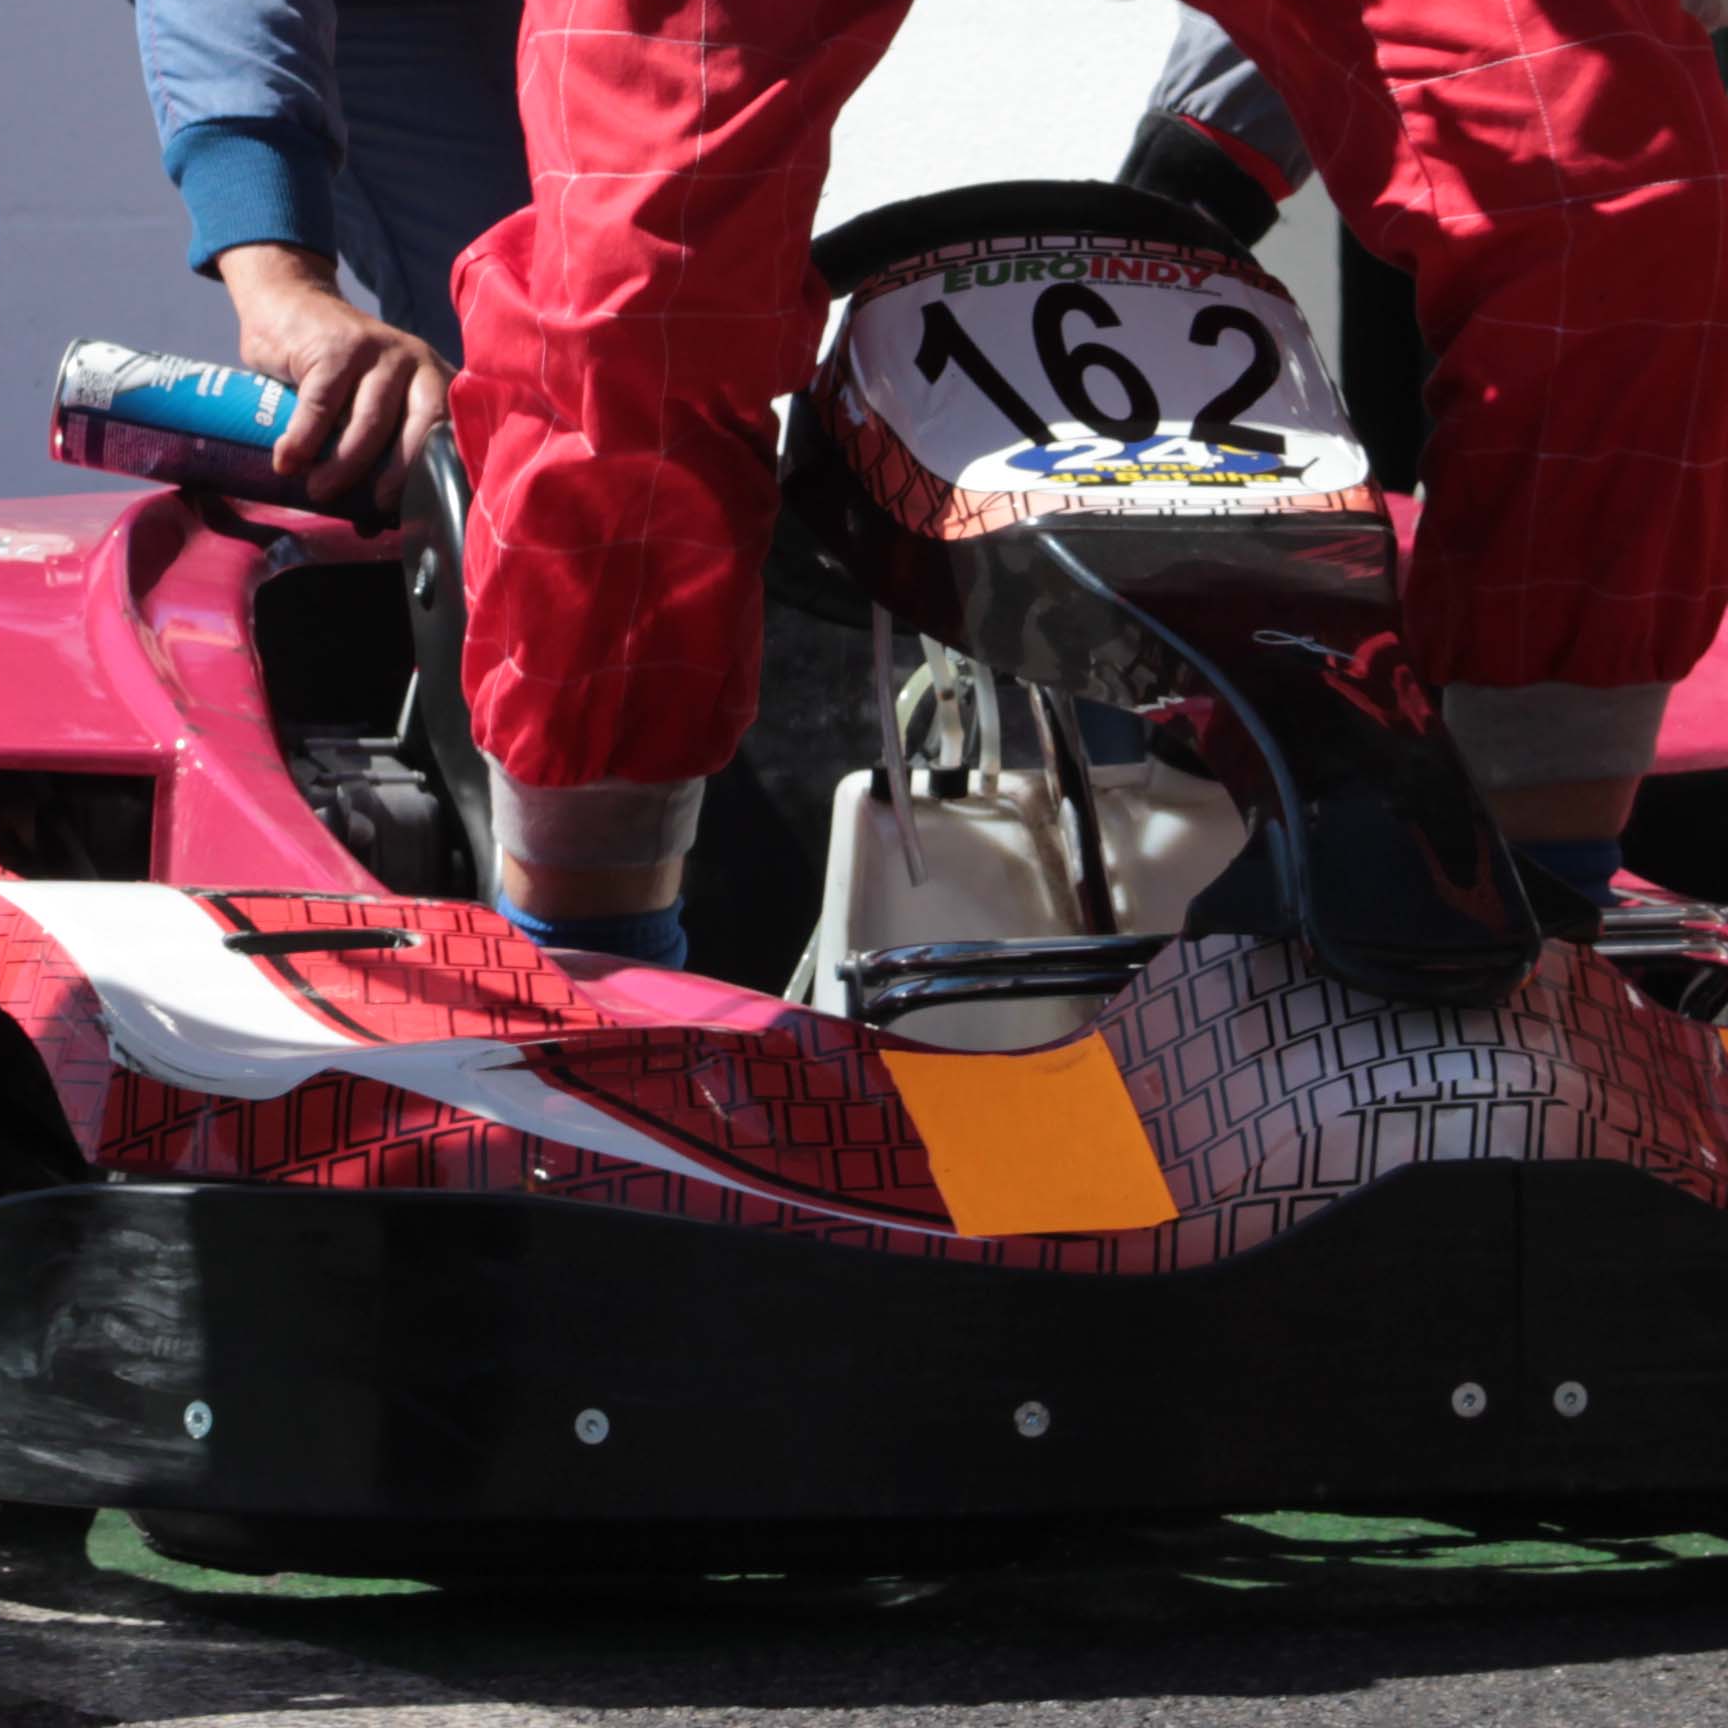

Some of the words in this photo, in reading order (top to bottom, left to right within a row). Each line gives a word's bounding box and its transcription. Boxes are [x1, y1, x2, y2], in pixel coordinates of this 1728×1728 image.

[942, 254, 1211, 294] EUROINDY
[914, 282, 1286, 456] 162
[1044, 435, 1224, 471] 24
[1048, 472, 1103, 483] da
